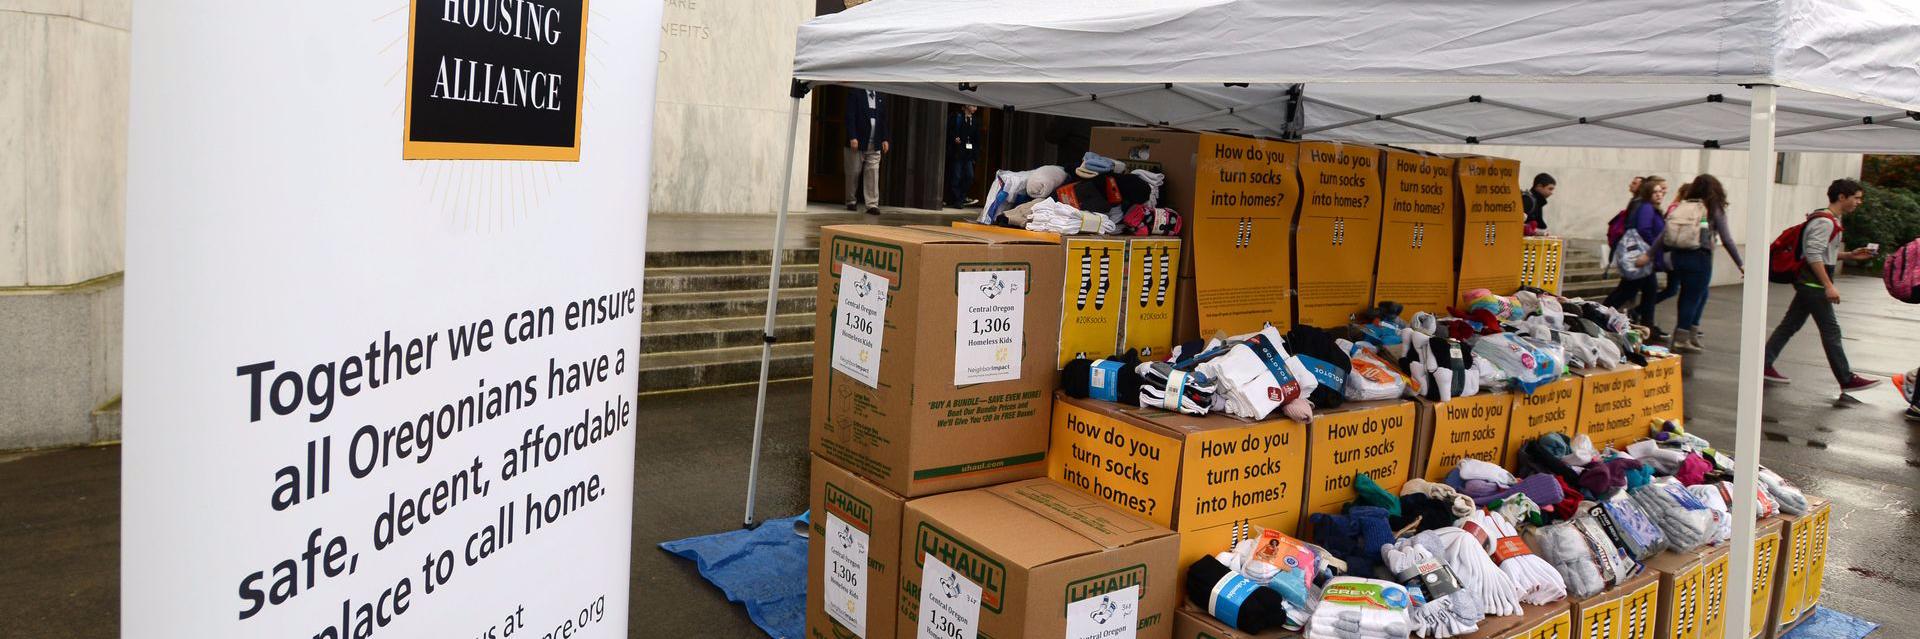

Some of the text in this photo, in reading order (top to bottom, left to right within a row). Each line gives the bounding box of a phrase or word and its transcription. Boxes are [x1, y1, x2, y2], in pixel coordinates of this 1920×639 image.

[442, 0, 561, 45] HOUSING
[430, 55, 562, 111] ALLIANCE
[1215, 144, 1285, 164] How do you
[1312, 150, 1335, 164] How
[1352, 156, 1372, 169] you
[1220, 168, 1282, 186] turn socks
[1397, 160, 1448, 178] How do you
[1488, 164, 1498, 176] do
[1500, 167, 1512, 180] you
[1320, 172, 1366, 188] turn socks
[1400, 181, 1443, 196] turn socks
[1490, 183, 1511, 194] socks
[1211, 190, 1284, 208] into homes?
[1312, 192, 1369, 208] into homes?
[1393, 198, 1445, 214] into homes?
[1484, 200, 1516, 212] homes?
[844, 298, 877, 316] Central Oregon
[968, 304, 1014, 314] Central Oregon
[846, 312, 872, 335] 1,306
[1076, 315, 1106, 324] #20Ksocks
[1140, 312, 1168, 322] #20Ksocks
[972, 318, 1010, 335] 1,306
[842, 330, 873, 348] Homeless Kids
[968, 336, 1013, 346] Homeless Kids
[236, 287, 636, 424] Together we can ensure
[968, 364, 1010, 374] NeighborImpact
[1593, 378, 1636, 394] How do you
[1005, 392, 1021, 402] EVEN
[1022, 390, 1042, 398] MORE!
[1522, 393, 1545, 406] How
[1556, 388, 1572, 402] you
[1594, 396, 1632, 414] turn socks
[954, 418, 968, 426] Give
[1000, 412, 1015, 420] FREE
[1016, 408, 1036, 418] Boxes!
[976, 406, 998, 414] Bundle
[999, 404, 1016, 412] Prices
[1447, 403, 1503, 421] How do you
[1544, 406, 1566, 422] socks
[271, 348, 626, 511] all Oregonians have a
[1328, 416, 1402, 440] How do you
[1588, 414, 1635, 434] into homes?
[1067, 412, 1160, 460] How do you
[1450, 426, 1496, 444] turn socks
[1201, 432, 1289, 458] How do you
[1334, 438, 1394, 464] turn socks
[961, 461, 1004, 472] uhaul.com
[1072, 442, 1149, 486] turn socks
[1440, 450, 1462, 466] into
[1207, 457, 1281, 486] turn socks
[1064, 464, 1090, 490] into
[1094, 476, 1156, 516] homes?
[1325, 474, 1351, 492] into
[1196, 482, 1287, 515] into homes?
[238, 396, 630, 621] safe, decent, affordable
[1591, 507, 1602, 517] 6
[1601, 513, 1612, 528] PAIR
[422, 547, 454, 595] to
[464, 506, 514, 566] call
[525, 473, 606, 534] home.
[831, 546, 845, 560] Central
[845, 556, 860, 570] Oregon
[922, 530, 998, 592] U-HAUL
[832, 560, 858, 587] 1,306
[830, 576, 859, 600] Homeless Kids
[1072, 572, 1140, 602] U-HAUL
[542, 594, 605, 639] ce.org
[929, 592, 948, 611] Central
[948, 604, 968, 626] Oregon
[503, 604, 524, 638] at
[931, 610, 963, 639] 1,306
[1103, 626, 1126, 639] Oregon
